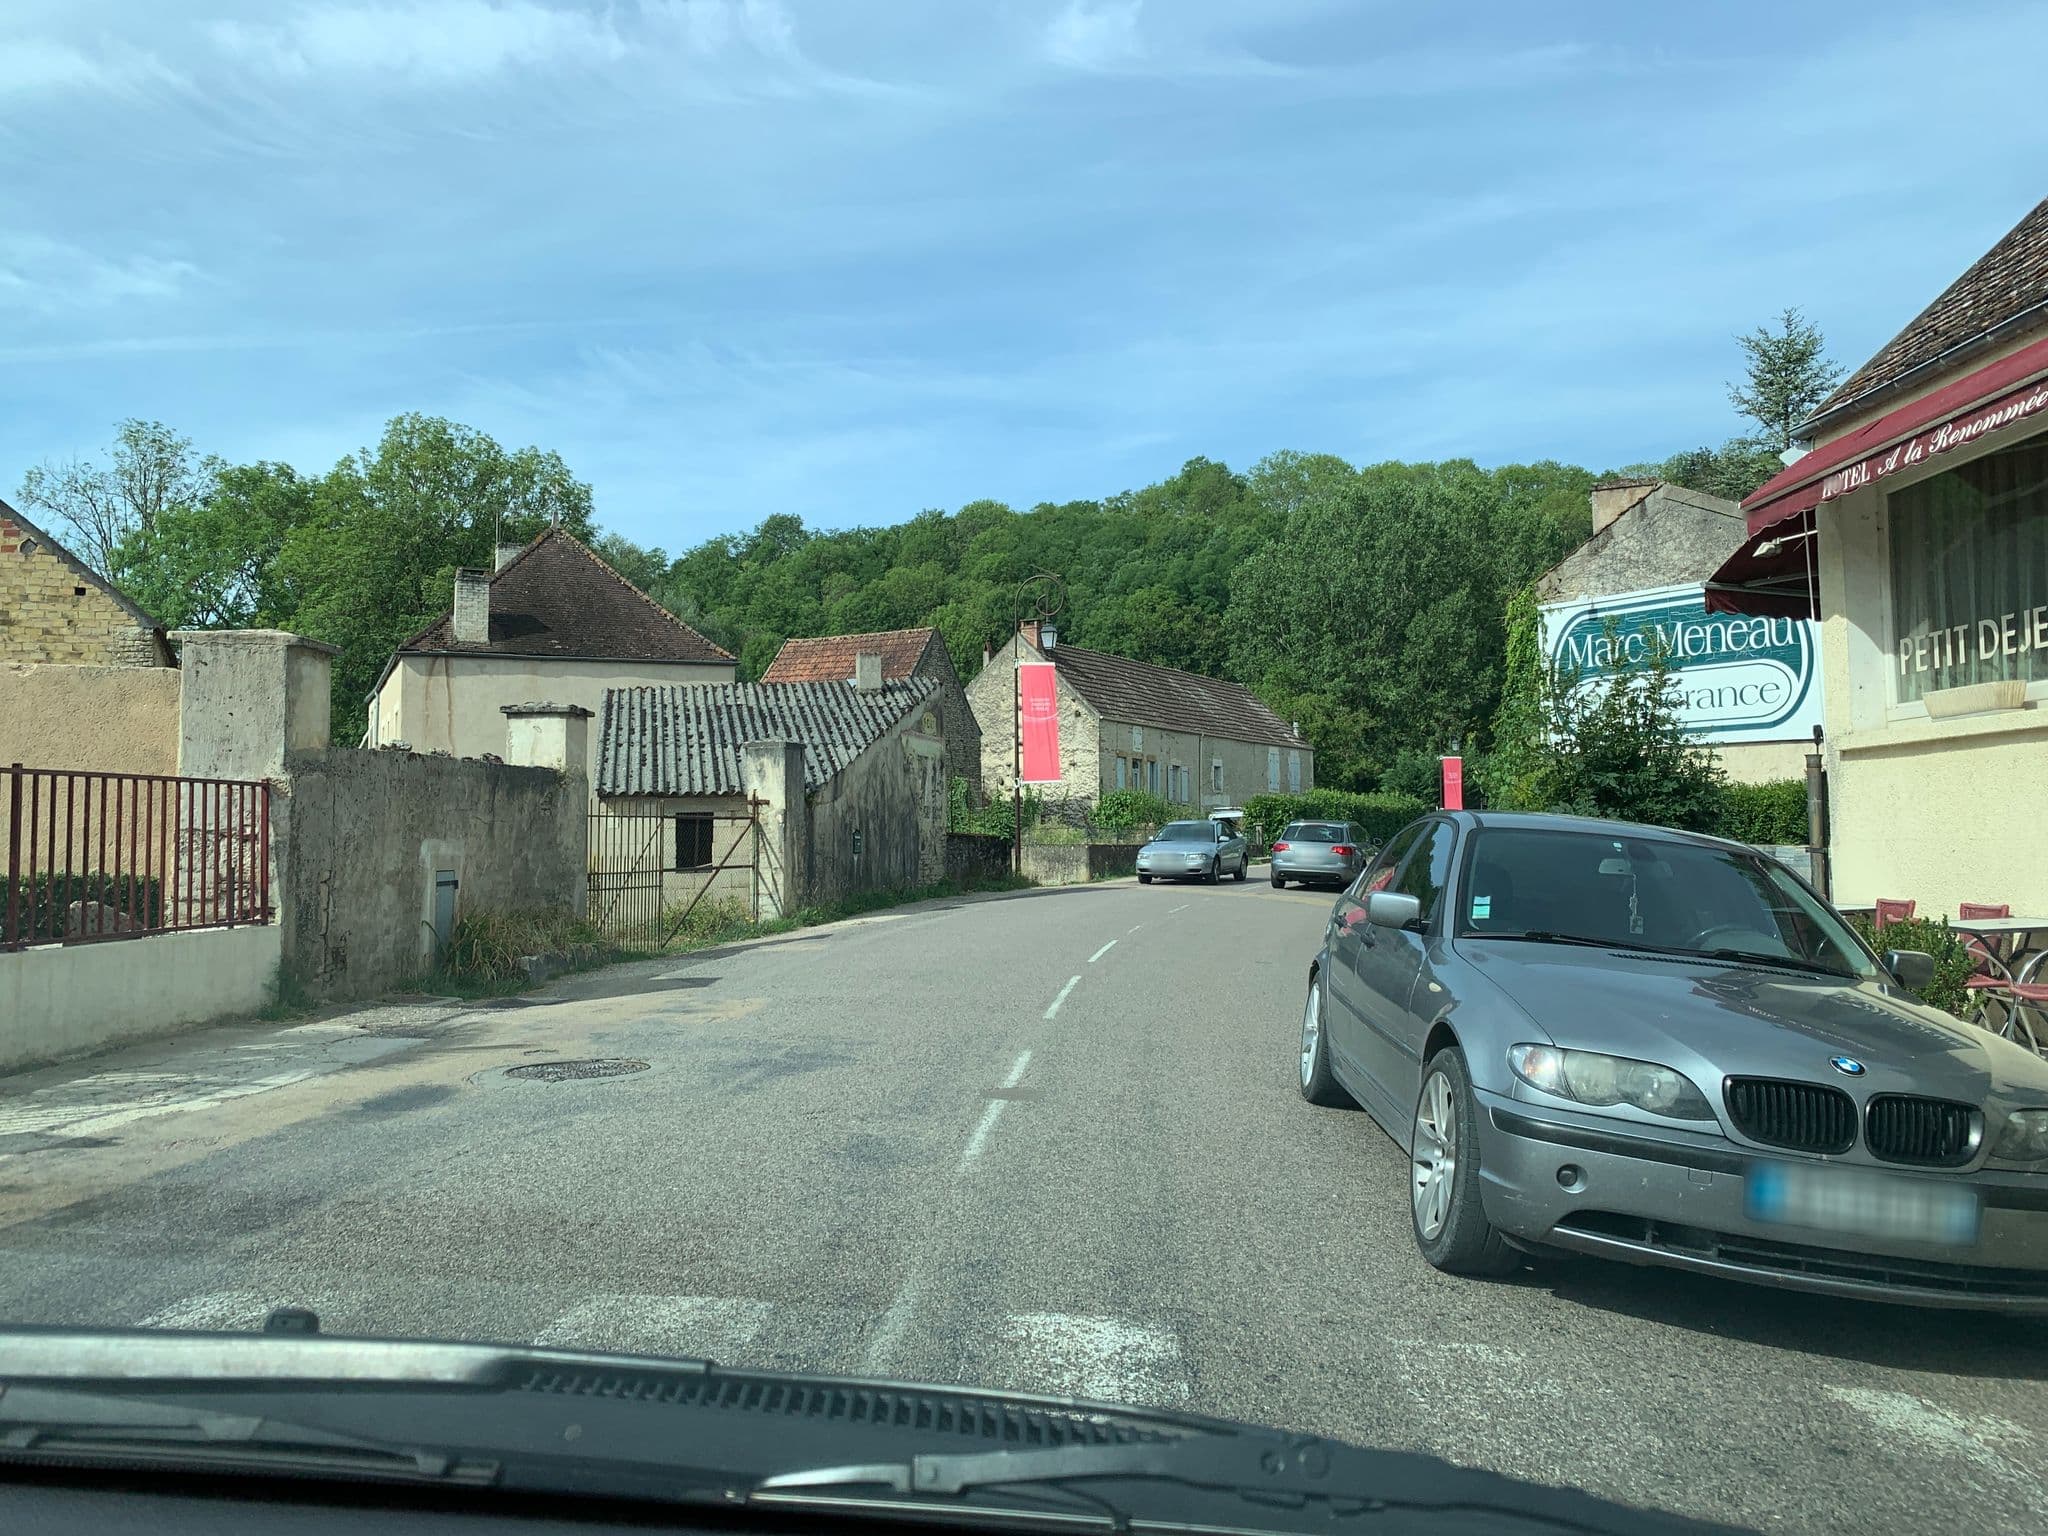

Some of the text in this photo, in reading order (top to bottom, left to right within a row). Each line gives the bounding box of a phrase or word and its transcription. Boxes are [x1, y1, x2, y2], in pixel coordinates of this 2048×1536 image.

[1878, 447, 1901, 475] A
[1904, 438, 1922, 465] la
[1928, 386, 2048, 454] Renommée
[1567, 616, 1794, 670] Marc Meneau
[1900, 606, 2048, 675] PETIT DEJE
